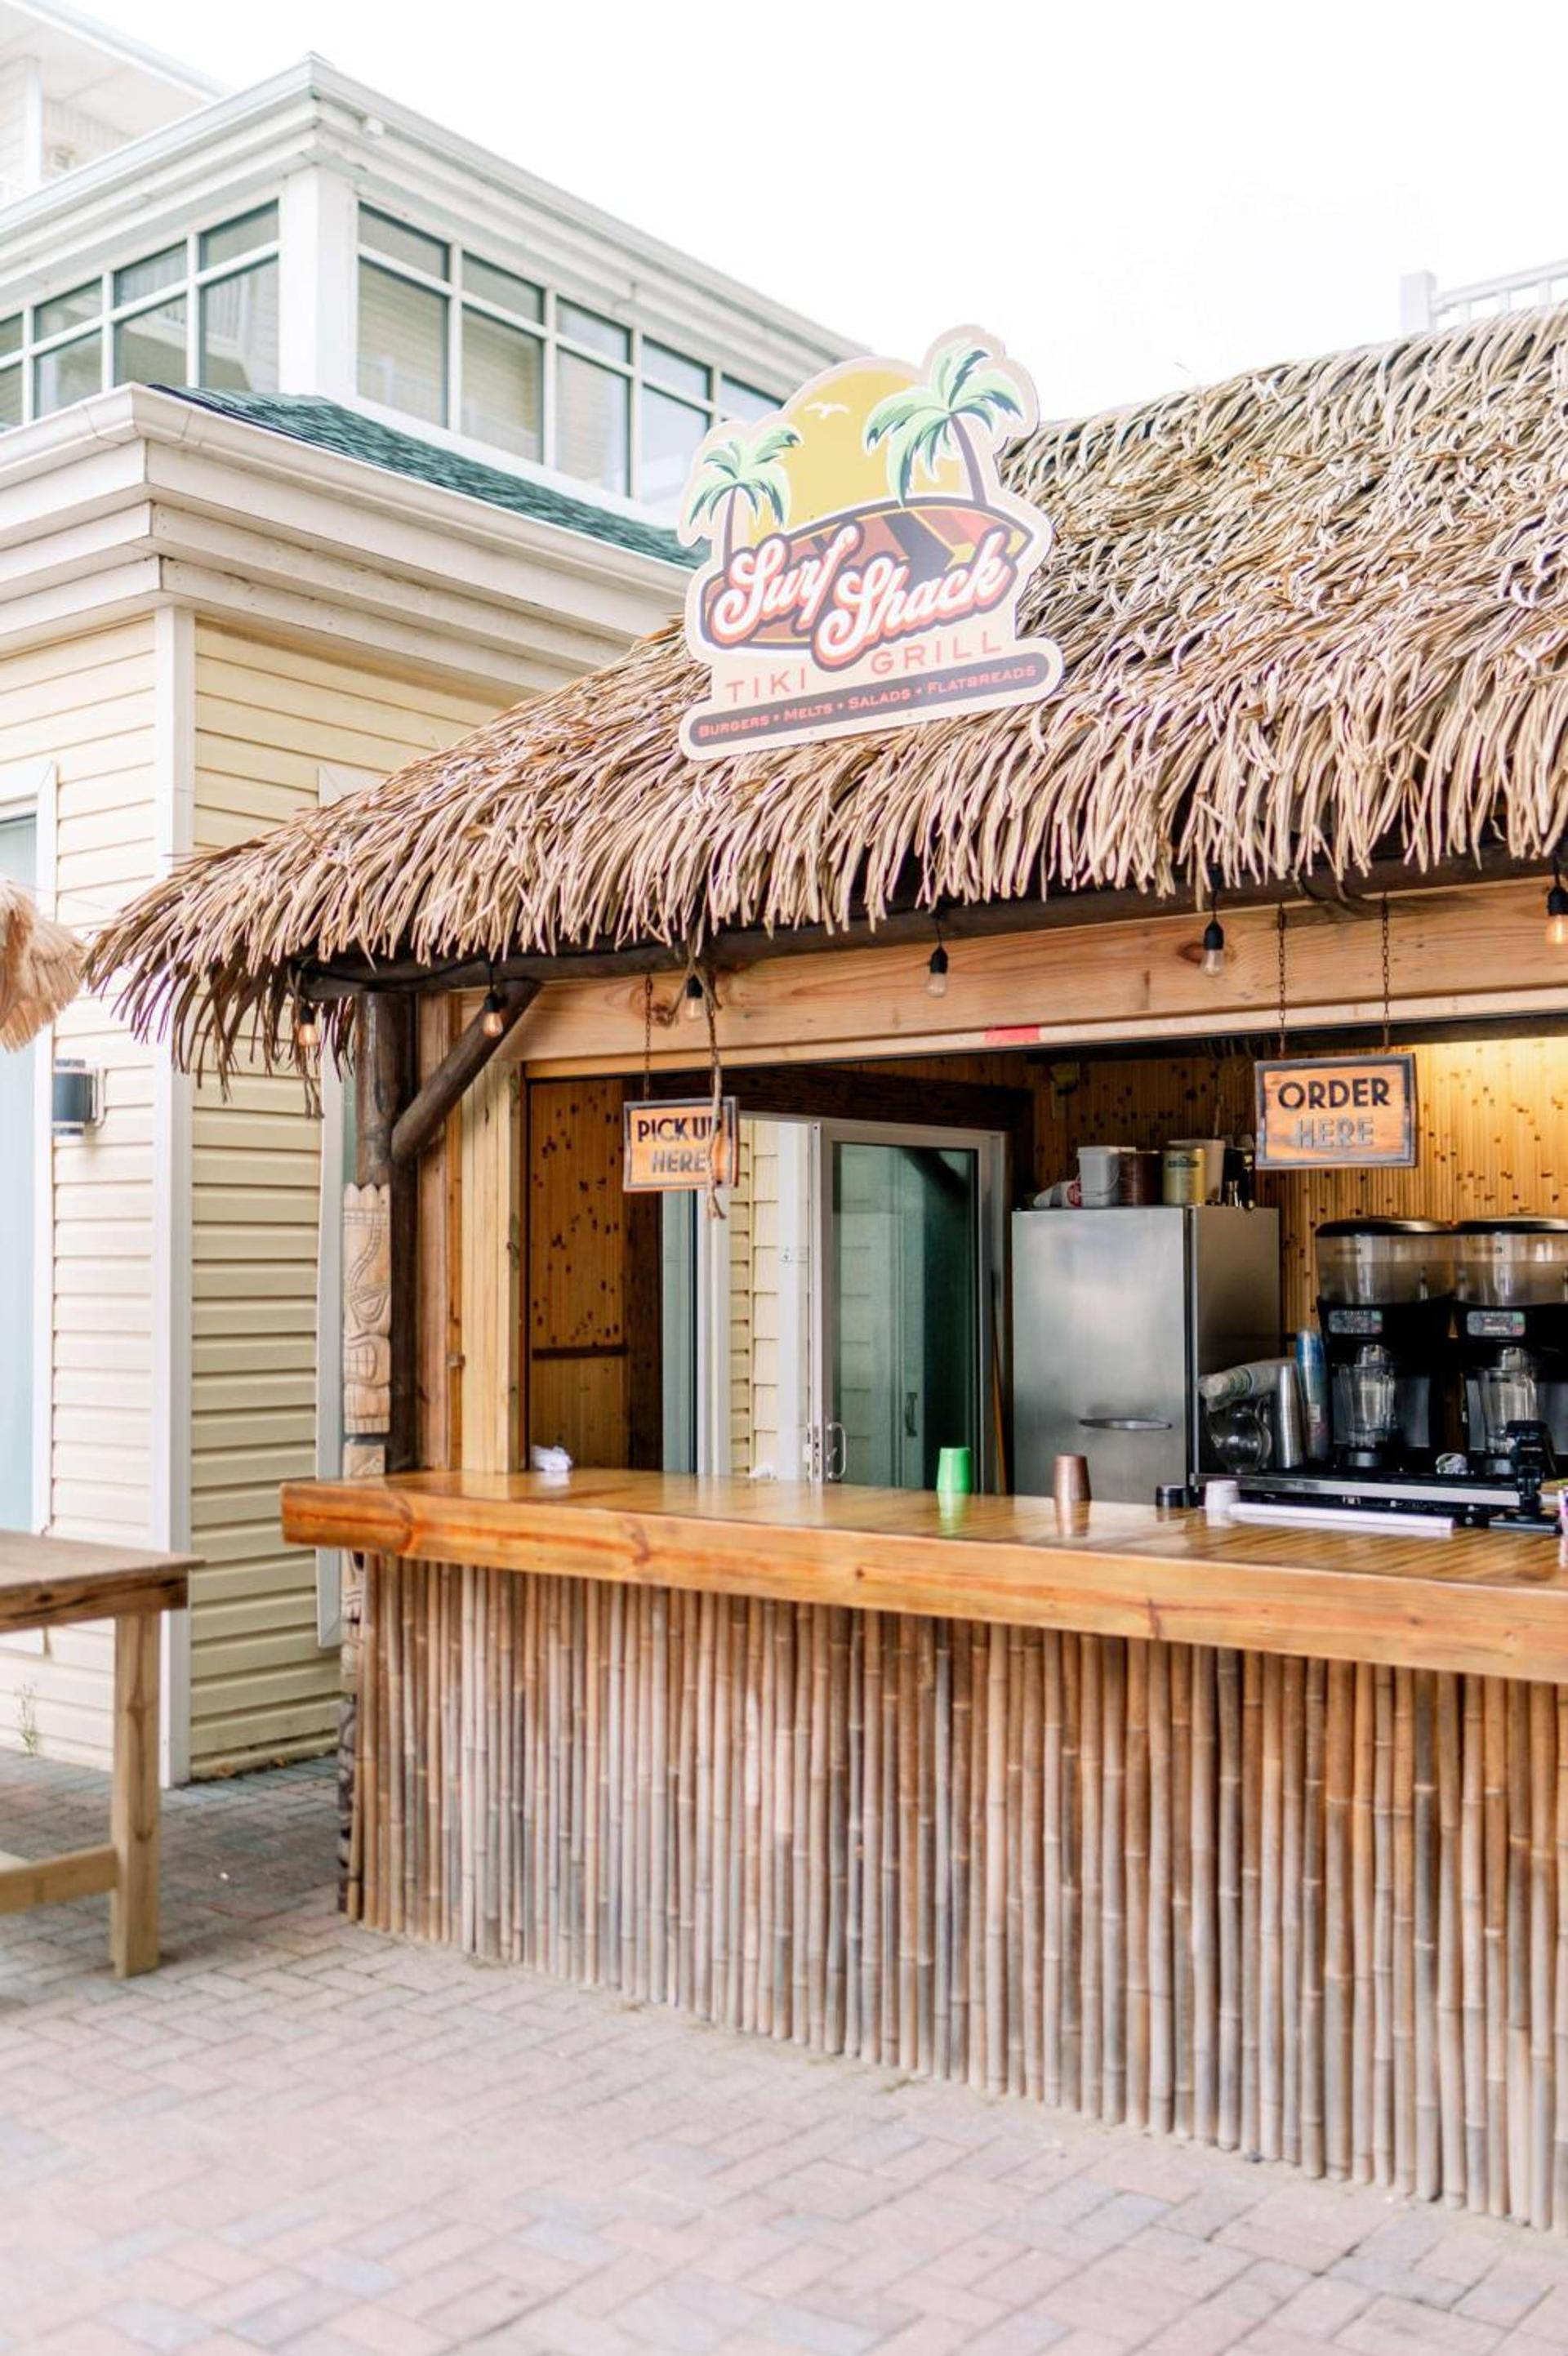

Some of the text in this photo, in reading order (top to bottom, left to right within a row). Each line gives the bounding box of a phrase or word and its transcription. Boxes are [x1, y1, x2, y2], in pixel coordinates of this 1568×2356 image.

[713, 525, 1009, 661] Surf Shack
[726, 630, 1001, 703] TIKI GRILL
[698, 665, 1037, 738] BURGERS MELTS SALADS FLATBREADS
[1278, 1077, 1391, 1109] ORDER
[638, 1116, 688, 1142] PICK
[1296, 1116, 1374, 1149] HERE
[653, 1147, 706, 1174] HERE
